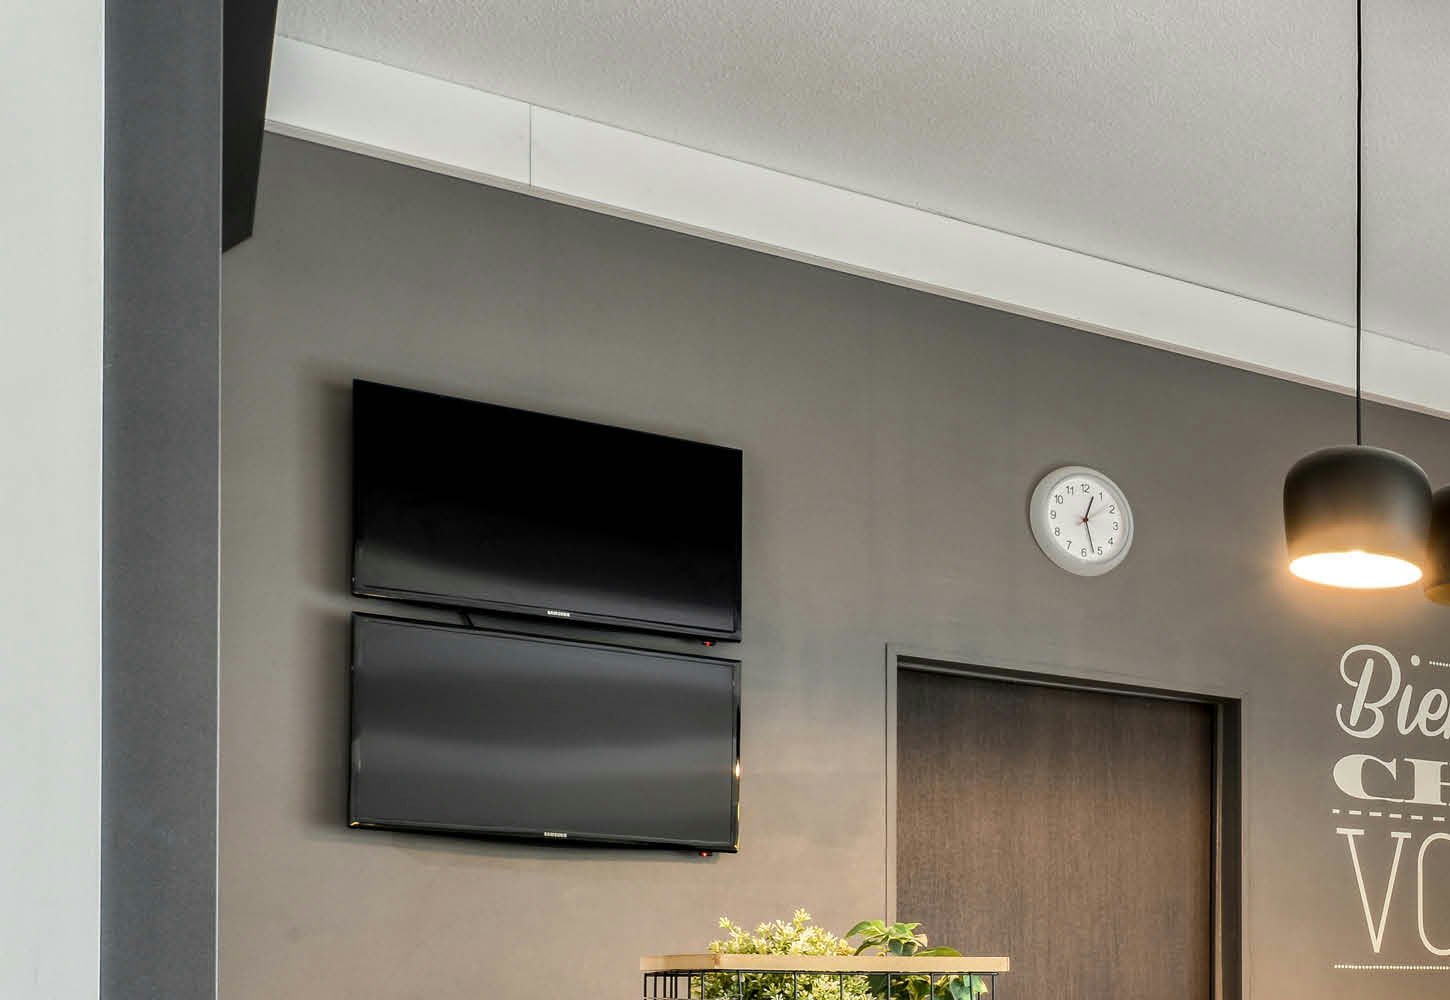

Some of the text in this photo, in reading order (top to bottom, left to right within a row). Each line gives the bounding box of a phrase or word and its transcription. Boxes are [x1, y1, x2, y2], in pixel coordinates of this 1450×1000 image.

[1066, 486, 1074, 495] 11
[1081, 484, 1090, 493] 12
[1055, 495, 1063, 504] 10
[1099, 492, 1103, 501] 1
[1109, 505, 1115, 514] 2
[1050, 511, 1056, 519] 9
[1113, 522, 1118, 530] 3
[1055, 527, 1060, 536] 8
[1066, 541, 1072, 549] 7
[1108, 537, 1113, 545] 4
[1081, 548, 1086, 557] 6
[1097, 547, 1103, 555] 5
